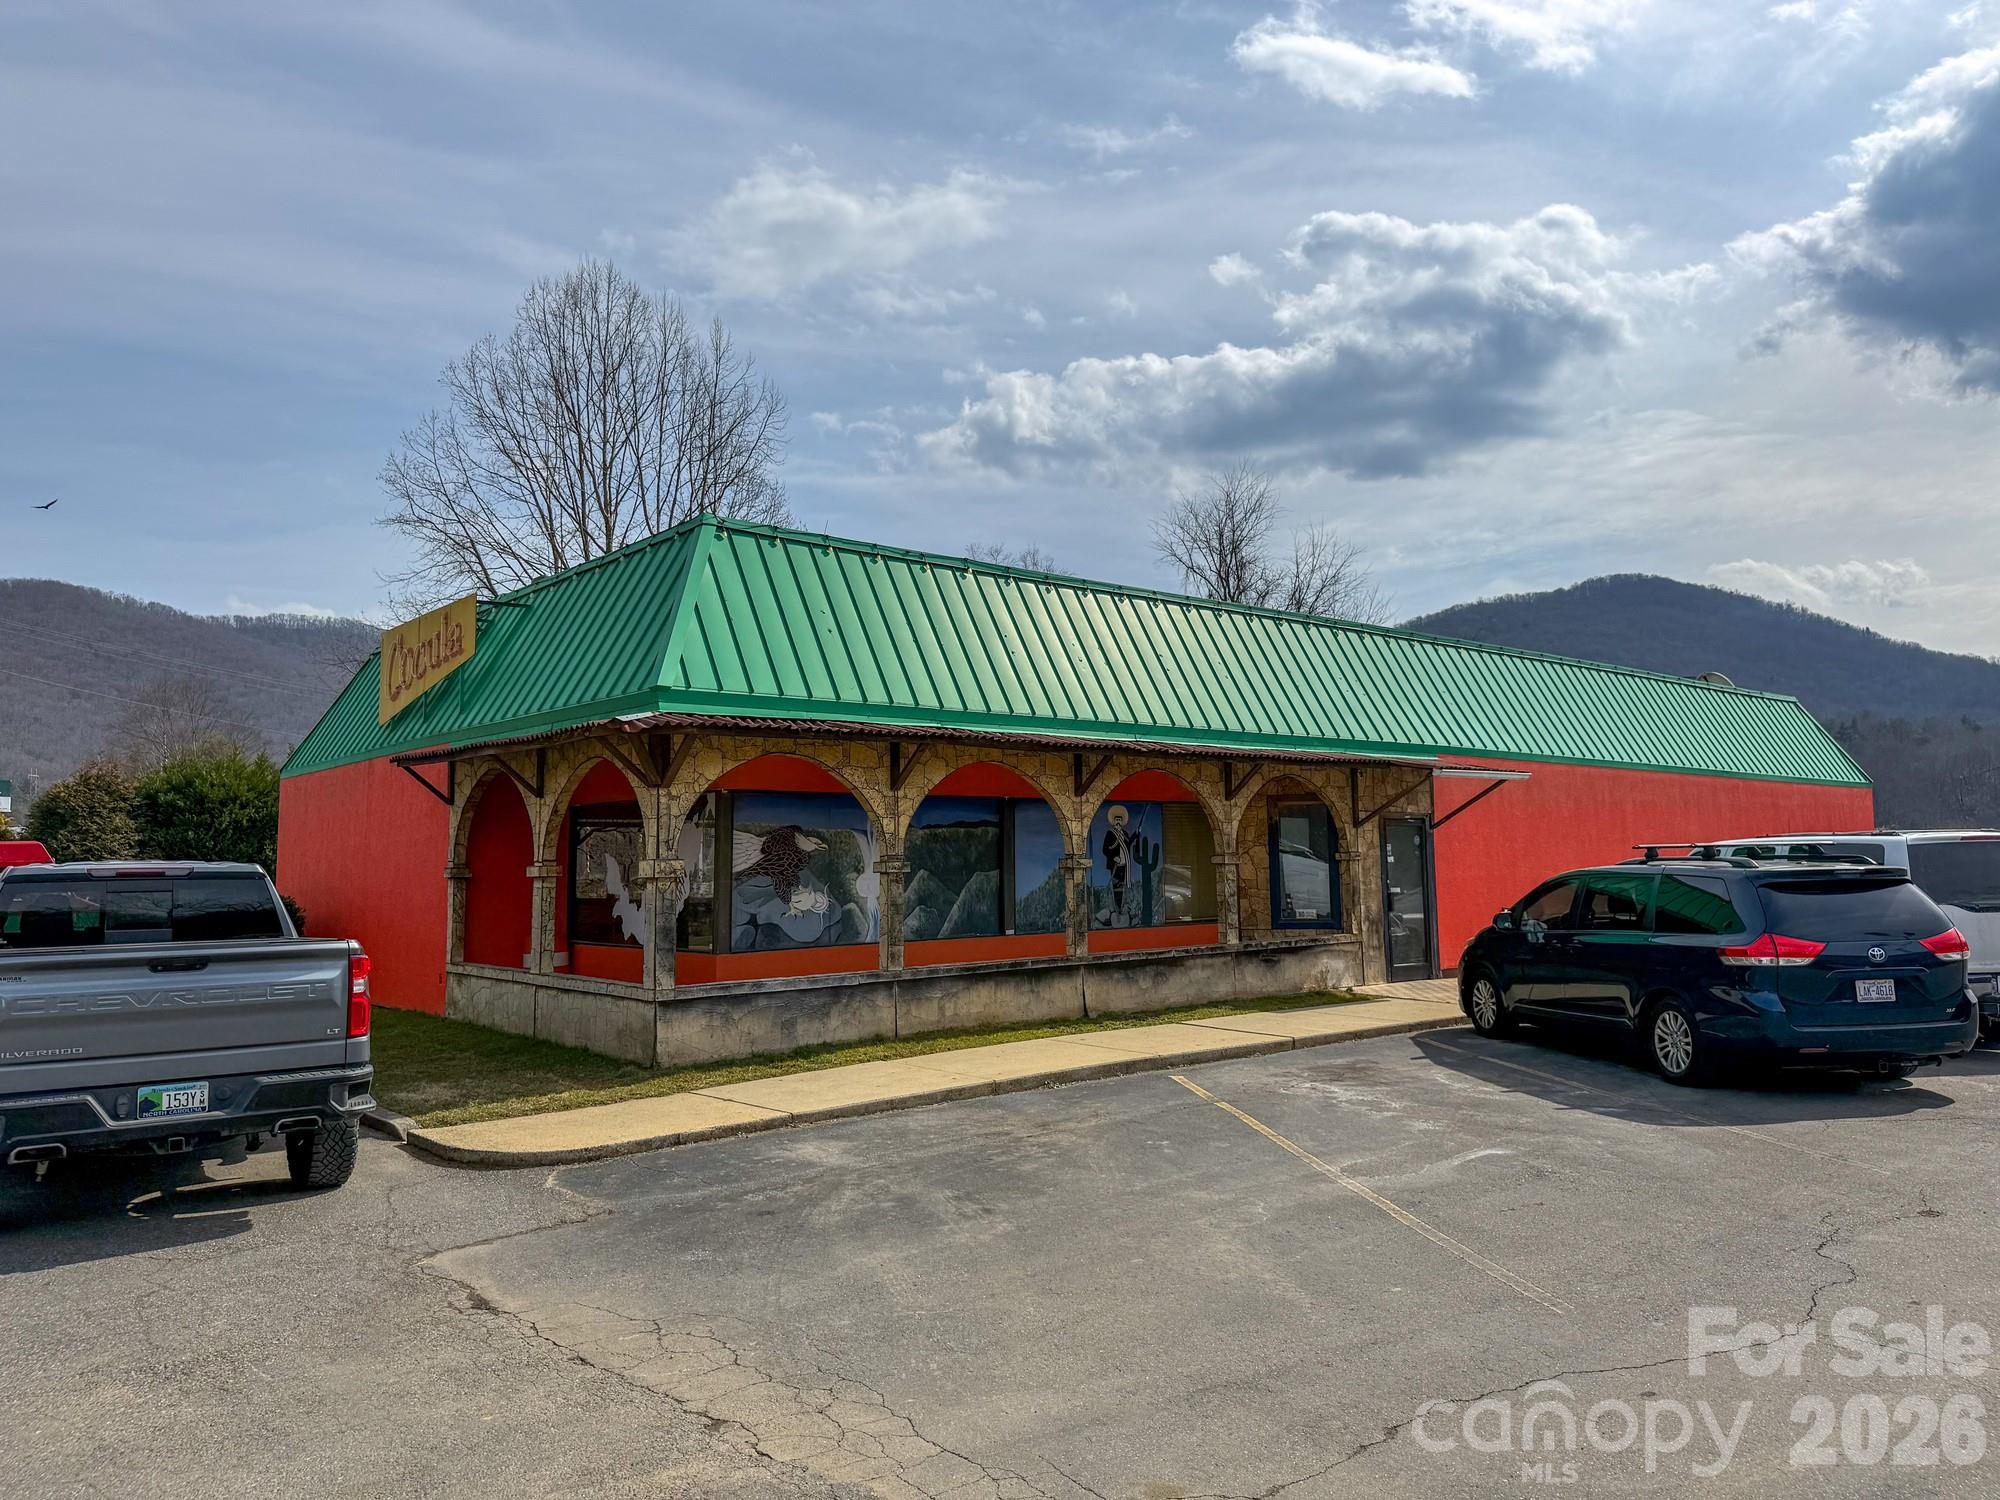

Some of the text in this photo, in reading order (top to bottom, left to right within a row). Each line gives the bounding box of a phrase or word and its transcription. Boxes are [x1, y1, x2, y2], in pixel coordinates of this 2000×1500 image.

[9, 983, 328, 1015] CHEVROLET
[0, 1047, 83, 1059] ILVERADO
[166, 1091, 197, 1109] 153Y
